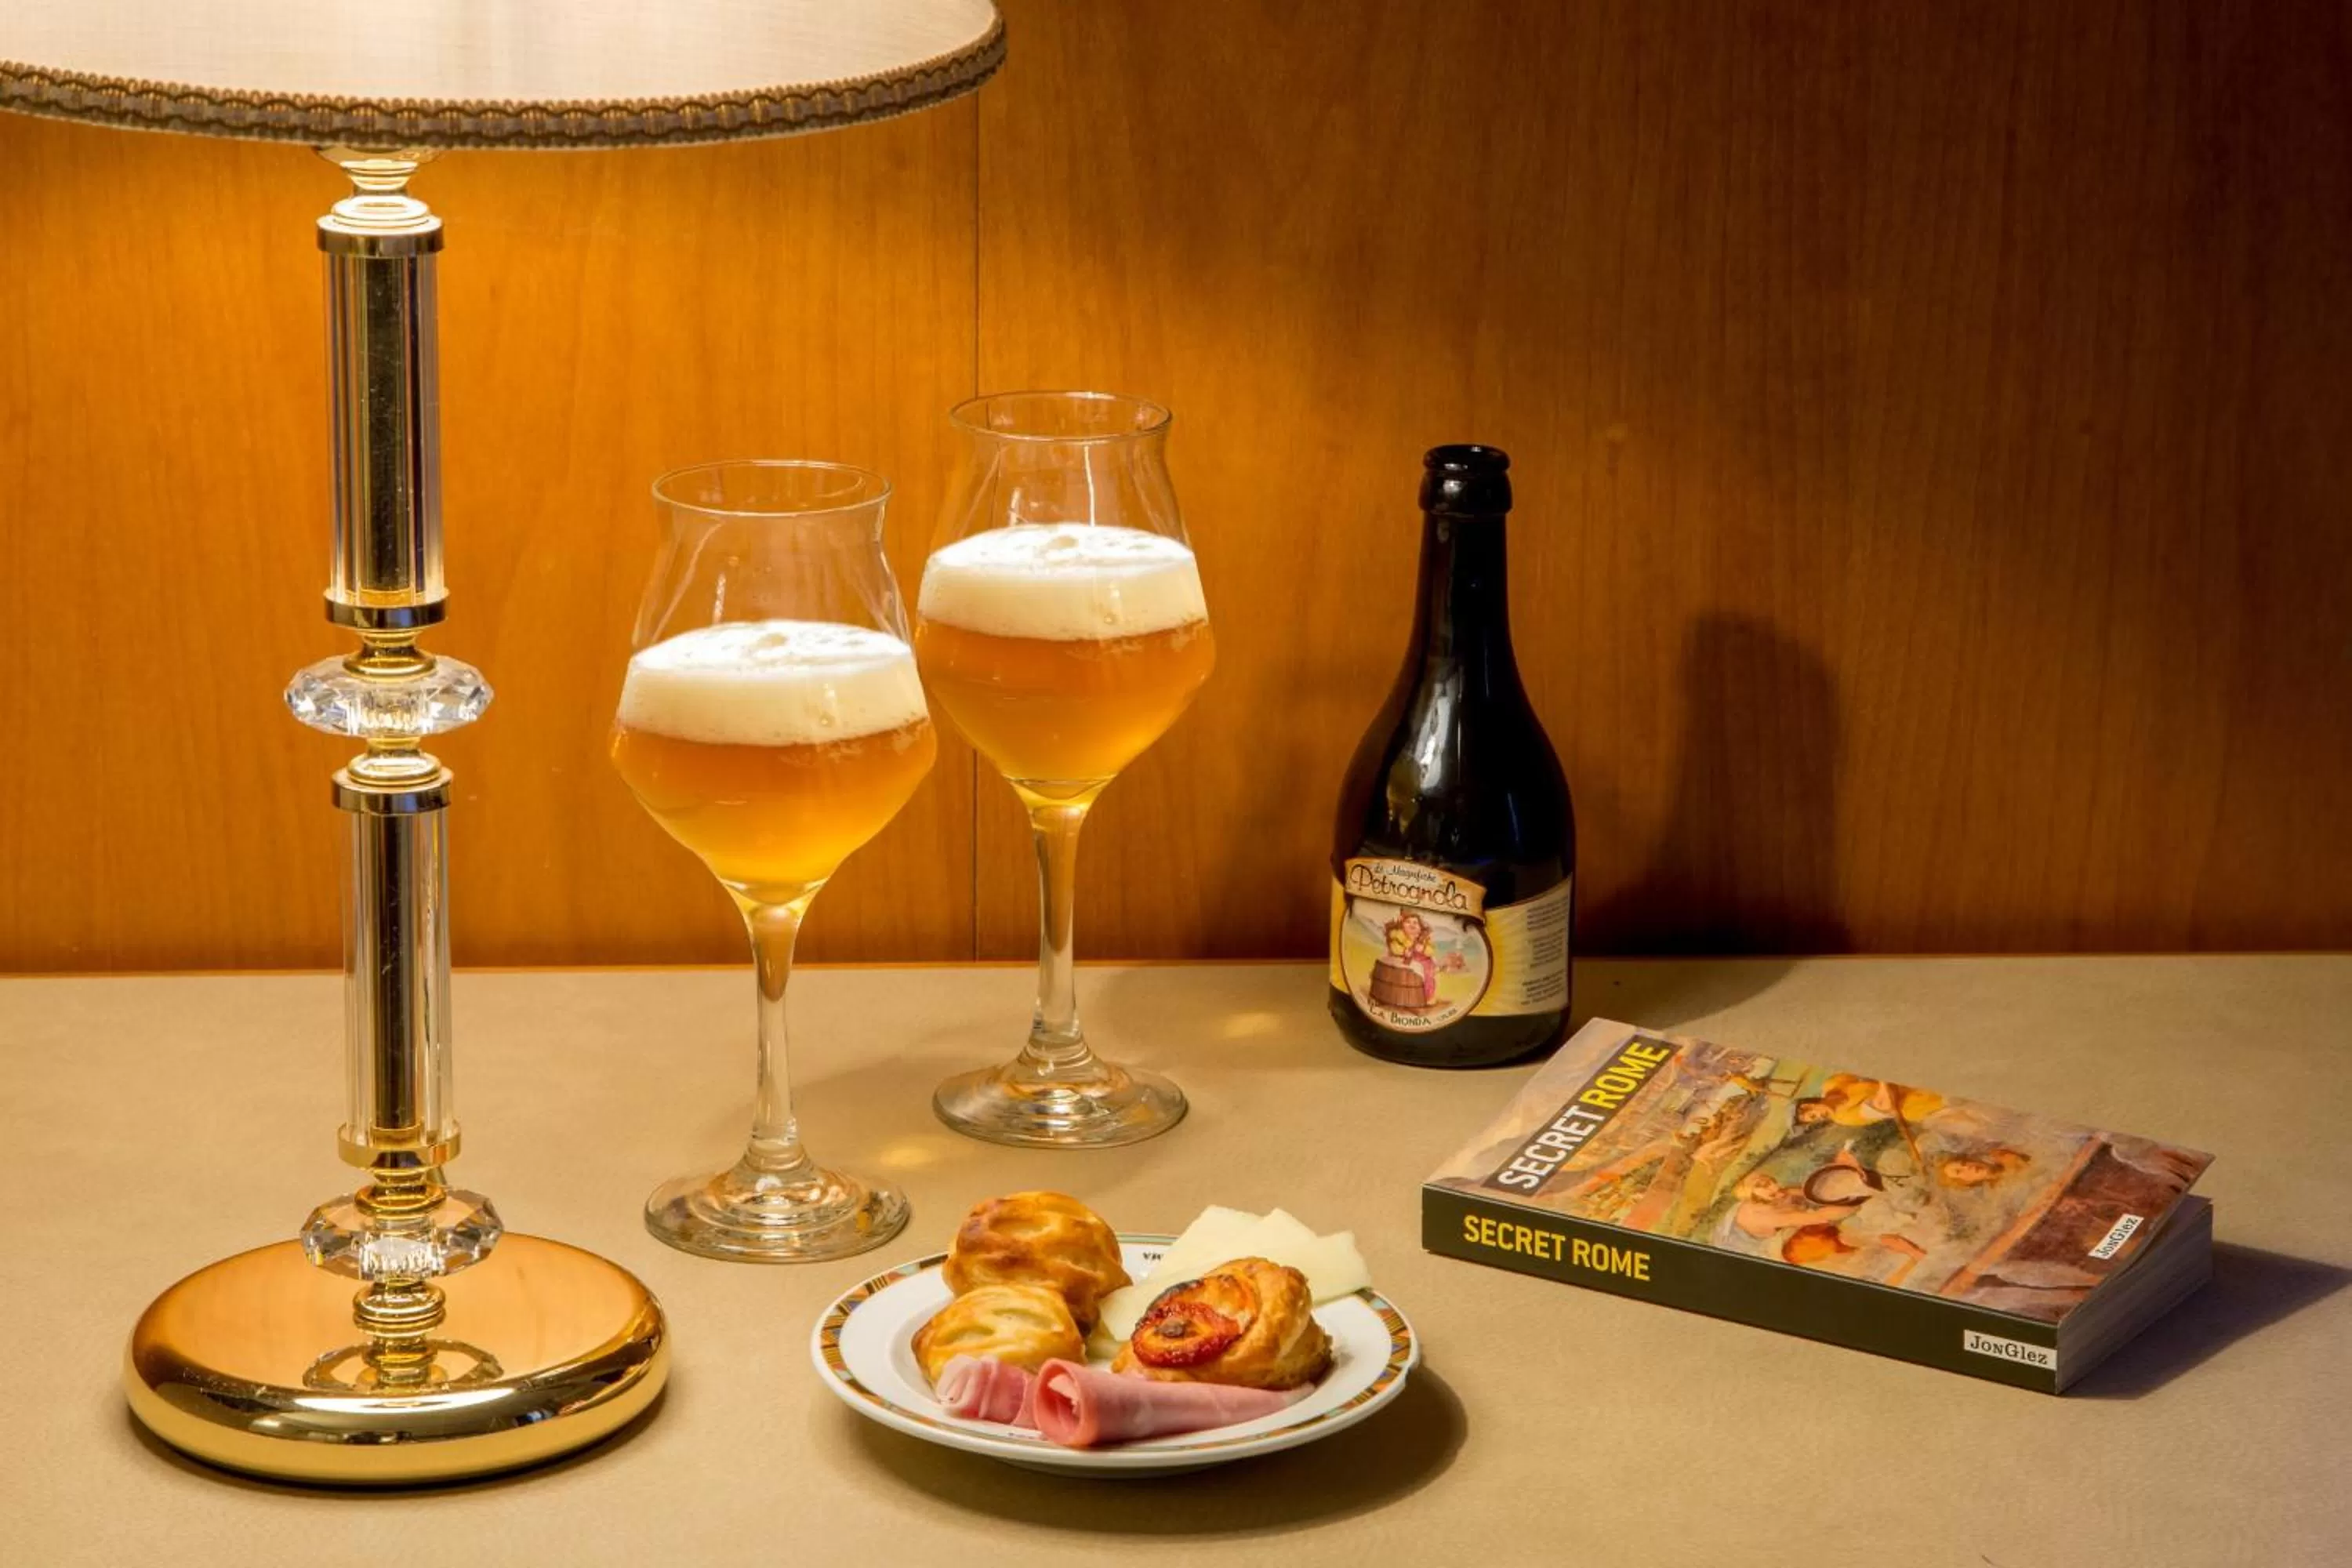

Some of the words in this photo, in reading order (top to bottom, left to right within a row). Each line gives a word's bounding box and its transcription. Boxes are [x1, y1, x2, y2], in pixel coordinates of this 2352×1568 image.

[1350, 863, 1468, 910] Petrognola
[1497, 1105, 1606, 1189] SECRET
[1578, 1041, 1671, 1109] ROME
[1463, 1214, 1566, 1261] SECRET
[1572, 1238, 1651, 1281] ROME
